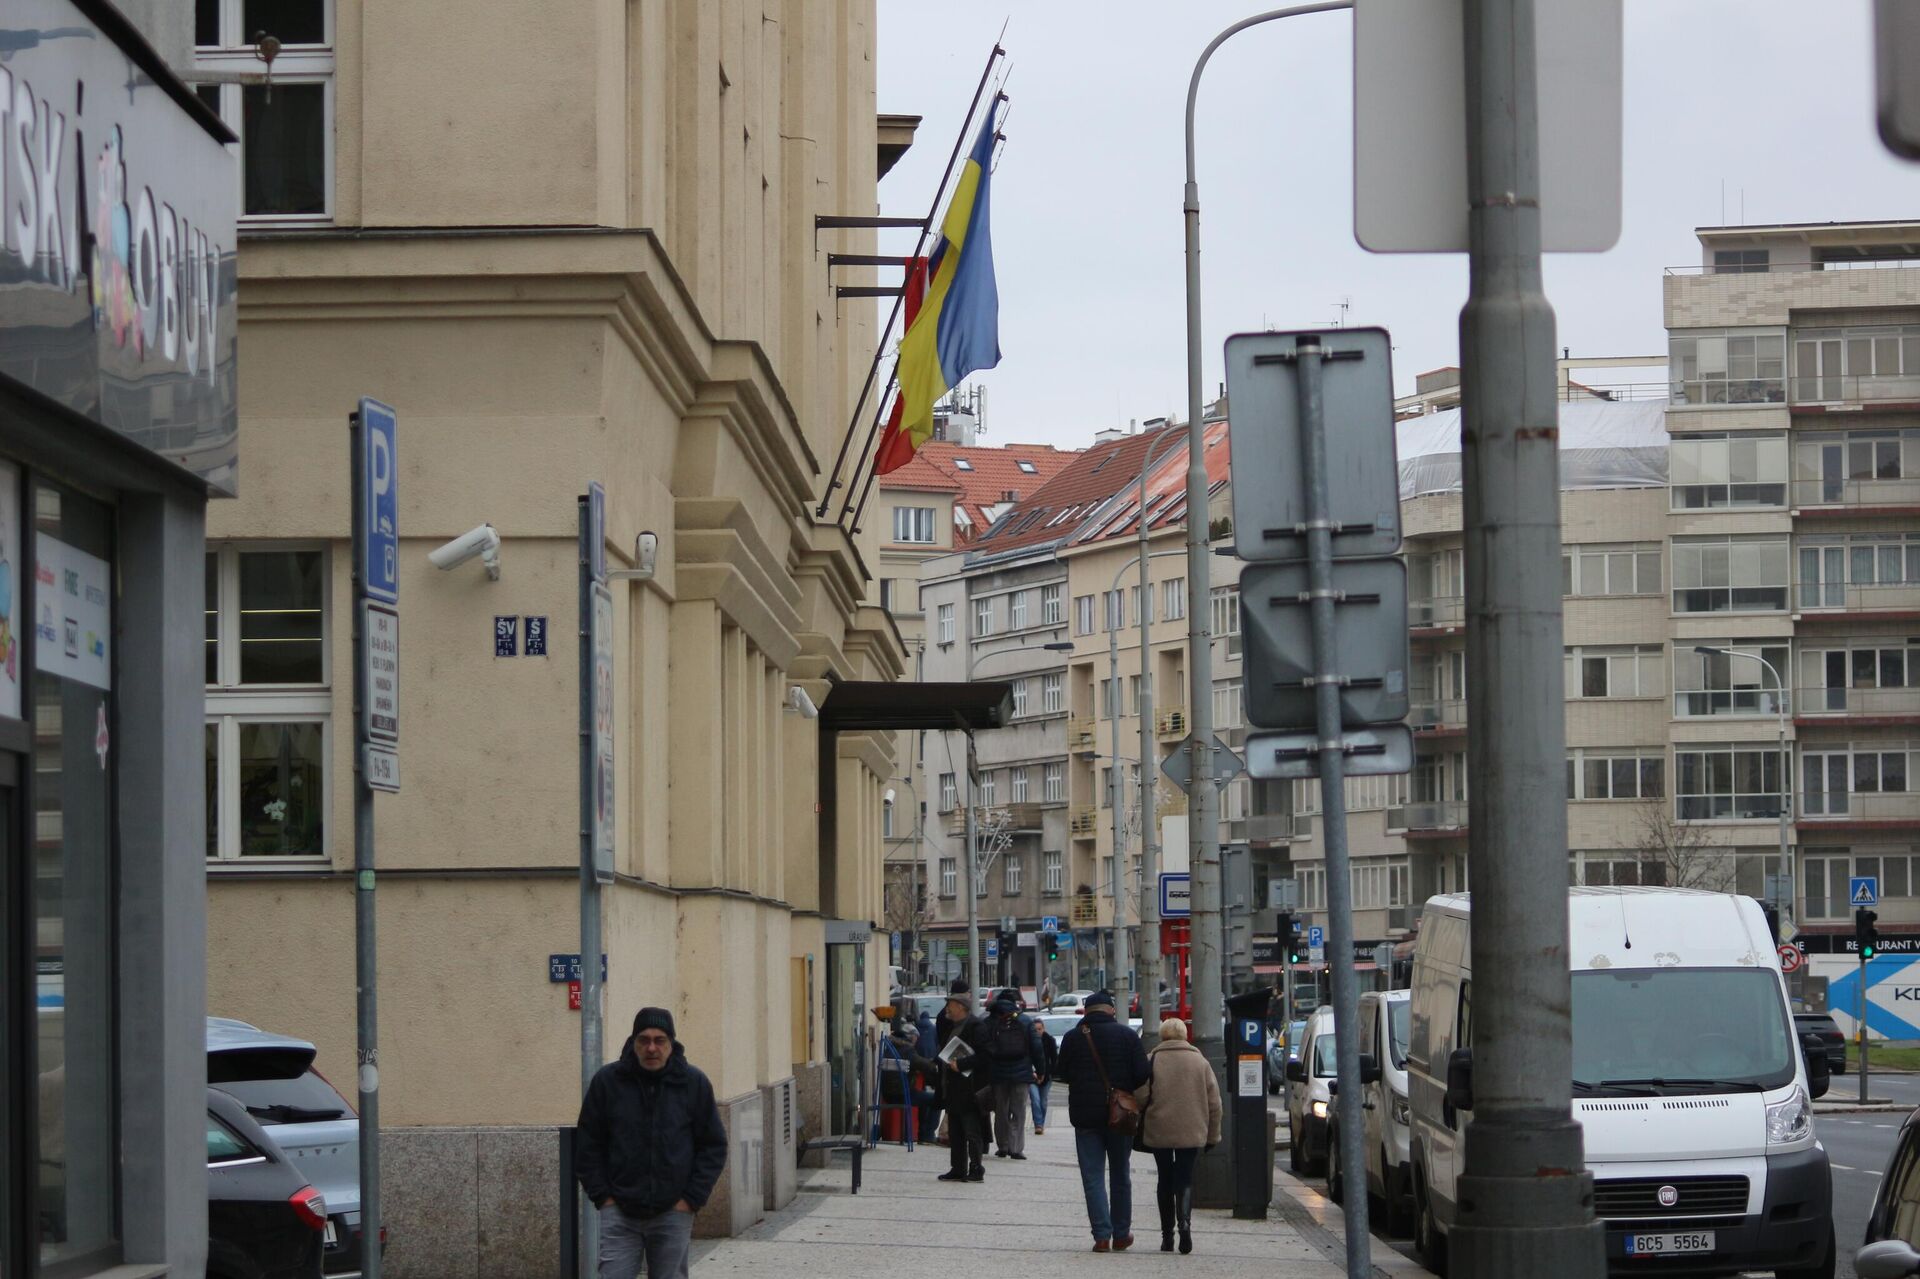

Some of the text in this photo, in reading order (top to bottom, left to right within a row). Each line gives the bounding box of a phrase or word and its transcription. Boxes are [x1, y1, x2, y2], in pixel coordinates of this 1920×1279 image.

[137, 186, 221, 388] OBUV
[372, 427, 390, 534] P
[497, 618, 516, 635] ŠV
[531, 618, 541, 635] Š
[1846, 940, 1912, 950] REURANT
[1245, 1022, 1259, 1041] P
[1662, 1191, 1674, 1201] FIAT
[1637, 1234, 1709, 1251] 6C5 5564
